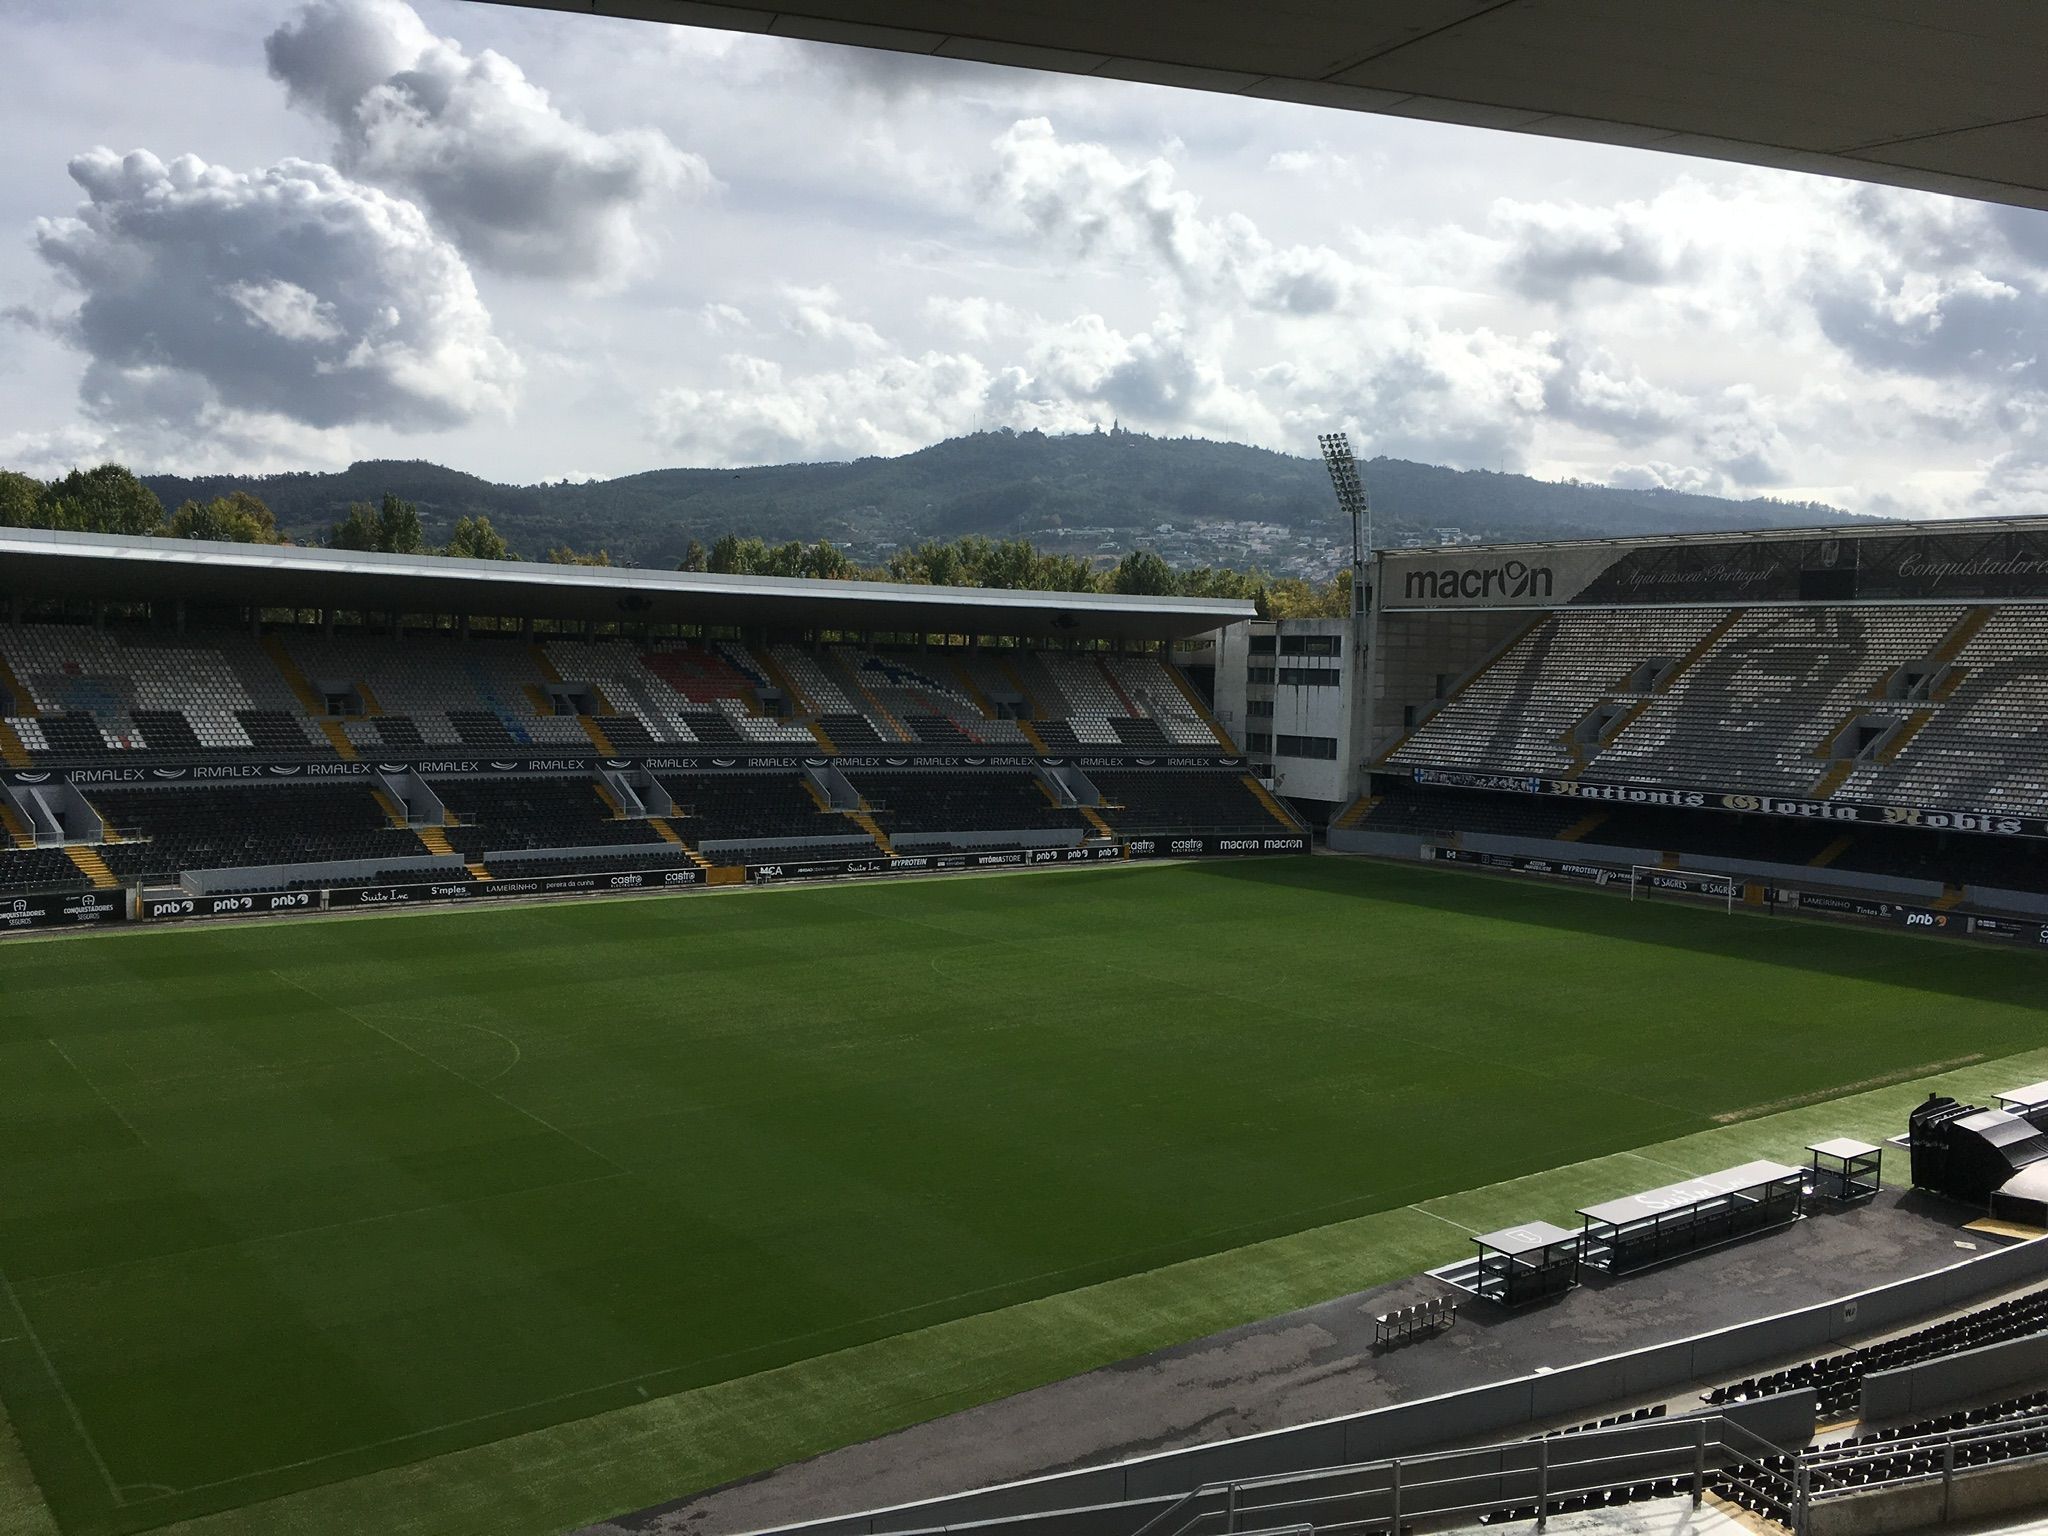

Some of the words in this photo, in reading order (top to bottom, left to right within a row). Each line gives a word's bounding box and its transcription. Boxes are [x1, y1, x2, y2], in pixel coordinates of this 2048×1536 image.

[1405, 561, 1553, 599] macron
[1657, 570, 1703, 584] nasceu
[1704, 561, 1780, 591] Portugal
[71, 769, 145, 782] IRMALEX
[193, 765, 262, 778] IRMALEX
[307, 763, 371, 775] IRMALEX
[418, 761, 479, 773] IRMALEX
[529, 759, 585, 770] IRMALEX
[646, 758, 698, 768] IRMALEX
[748, 757, 798, 768] IRMALEX
[833, 757, 880, 766] IRMALEX
[913, 757, 959, 767] IRMALEX
[990, 757, 1035, 767] IRMALEX
[1080, 757, 1124, 767] IRMALEX
[1167, 757, 1210, 767] IRMALEX
[1552, 781, 1705, 807] Nationis
[1723, 794, 1859, 821] Gloria
[1129, 839, 1155, 850] astro
[1171, 838, 1203, 849] castro
[1220, 839, 1259, 850] macron
[1264, 838, 1303, 850] macron
[1036, 852, 1051, 862] pnb
[1068, 850, 1081, 860] pnb
[1098, 847, 1112, 858] pnb
[890, 858, 928, 867] MYPROTEIN
[1562, 864, 1598, 875] MYPROTEIN
[611, 874, 643, 885] castro
[665, 870, 696, 881] castro
[486, 882, 538, 893] LAMEIRINHO
[1661, 878, 1687, 890] SAGRES
[214, 899, 240, 912] pnb
[271, 896, 297, 909] pnb
[1803, 898, 1851, 909] LAMEIRINHO
[63, 904, 114, 914] CONQUISTADORES
[154, 901, 181, 916] pnb
[1856, 905, 1878, 915] Tintas
[0, 910, 46, 919] ONQUISTADORES
[77, 913, 100, 921] SEGUROS
[1907, 913, 1933, 926] pnb
[9, 918, 32, 926] SEGUROS
